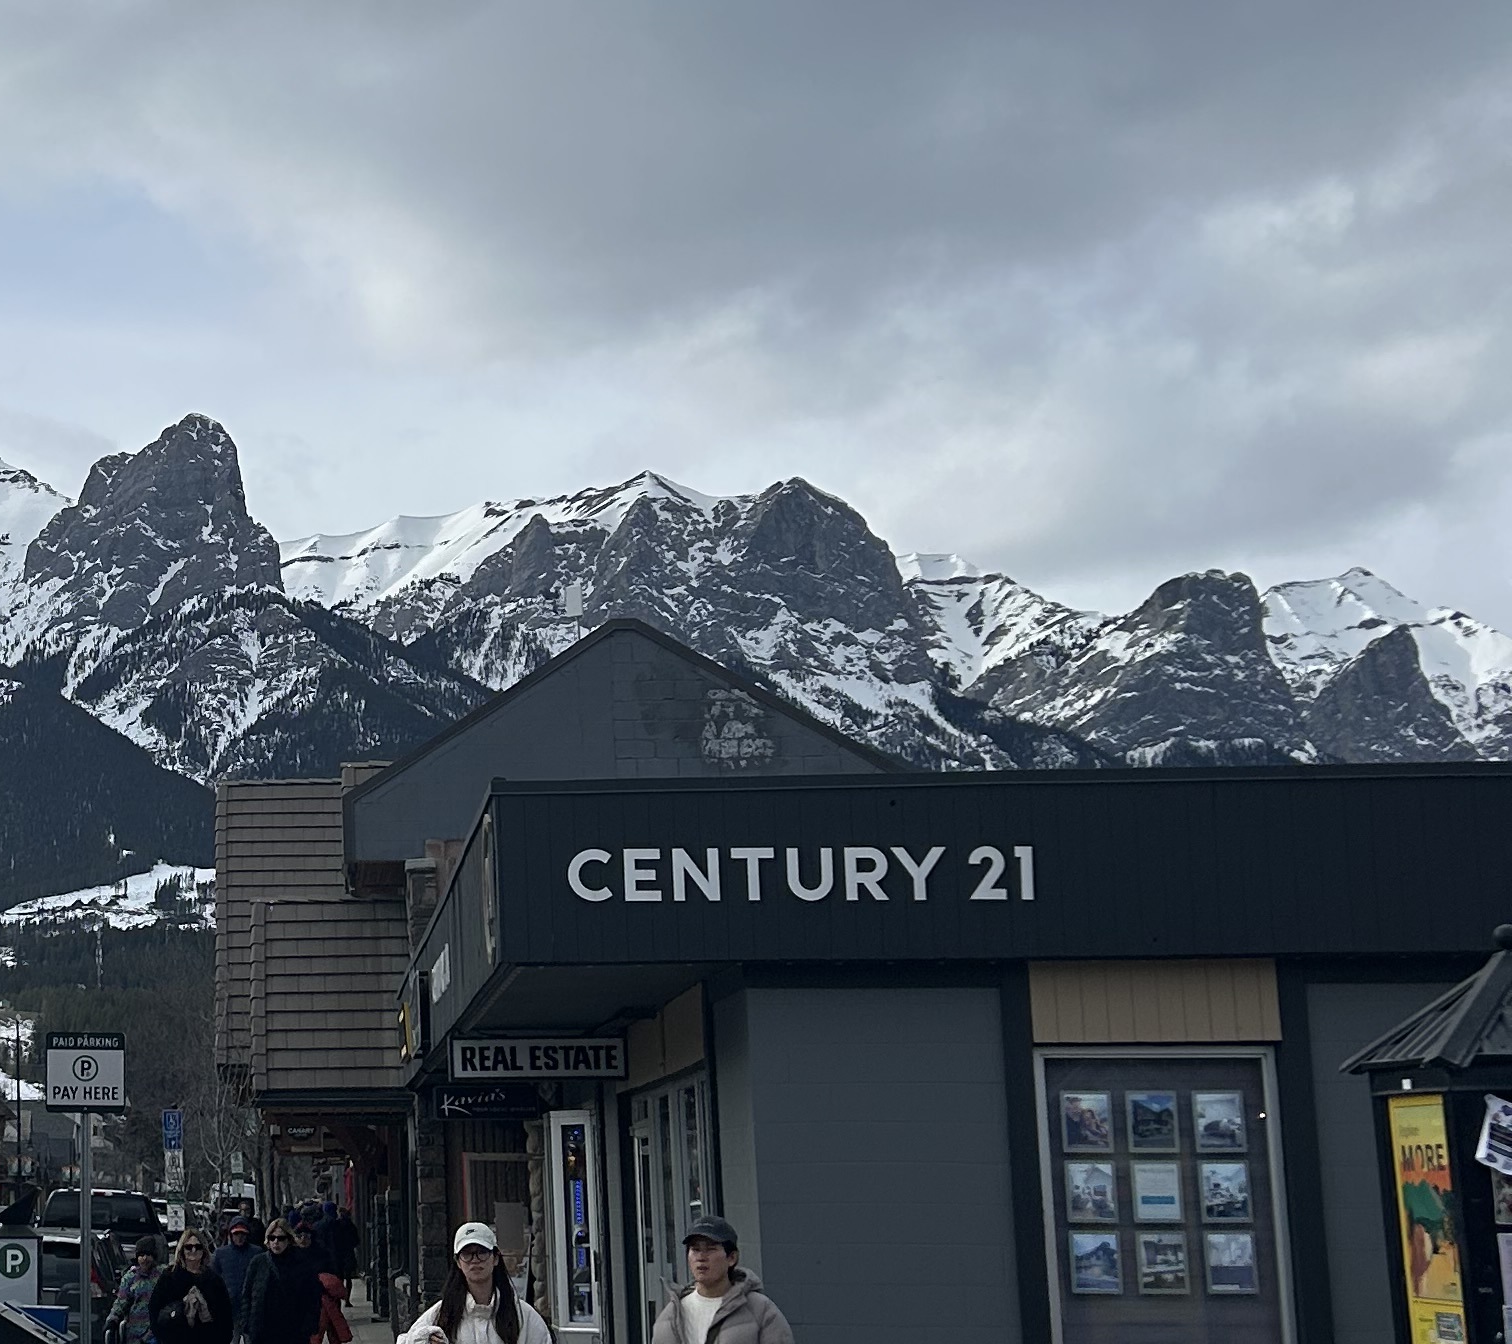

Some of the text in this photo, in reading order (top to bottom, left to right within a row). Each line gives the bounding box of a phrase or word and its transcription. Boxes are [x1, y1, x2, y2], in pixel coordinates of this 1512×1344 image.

[567, 845, 1035, 902] CENTURY 21
[52, 1036, 119, 1048] PAID PARKING
[460, 1044, 619, 1072] REAL ESTATE
[52, 1085, 119, 1101] PAY HERE
[1401, 1143, 1445, 1171] MORE
[6, 1249, 24, 1273] P
